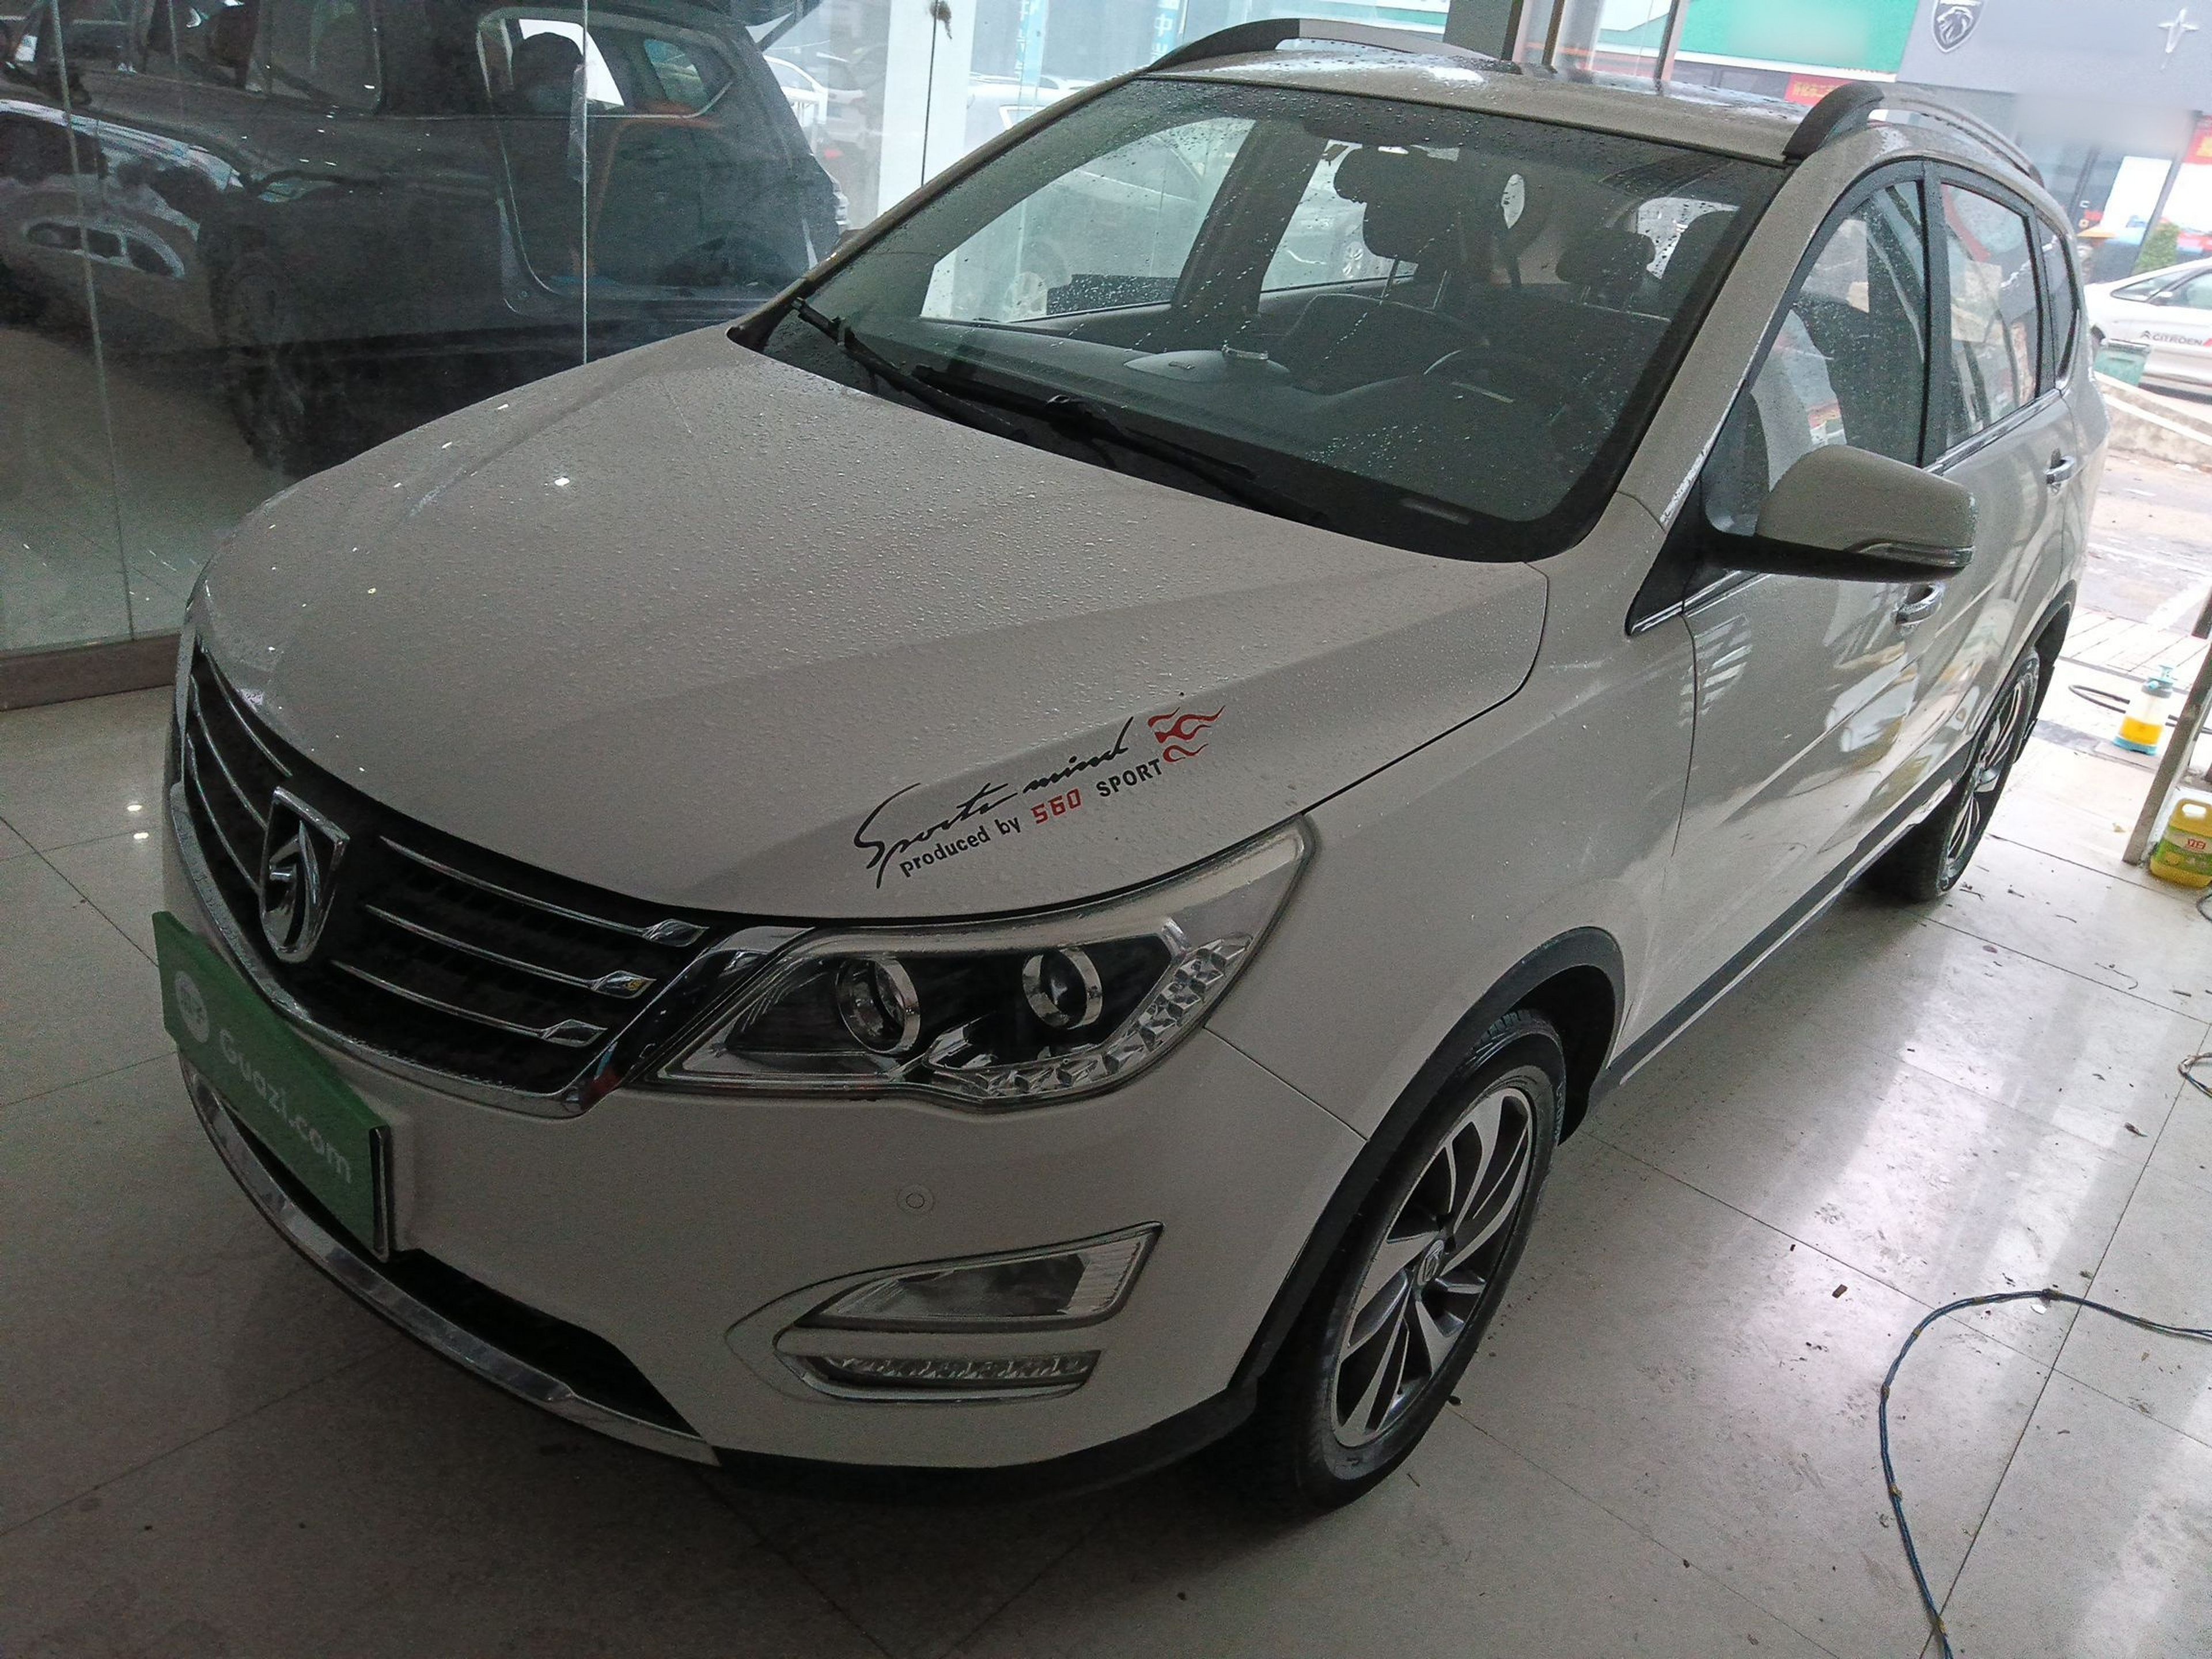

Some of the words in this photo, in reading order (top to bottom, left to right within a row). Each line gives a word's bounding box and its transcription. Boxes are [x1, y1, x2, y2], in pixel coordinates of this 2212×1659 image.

[1022, 716, 1135, 794] mind
[899, 825, 991, 877] produced
[994, 816, 1021, 834] by
[1031, 788, 1081, 824] 560
[1096, 759, 1164, 797] SPORT
[219, 1028, 352, 1184] Guazi.com
